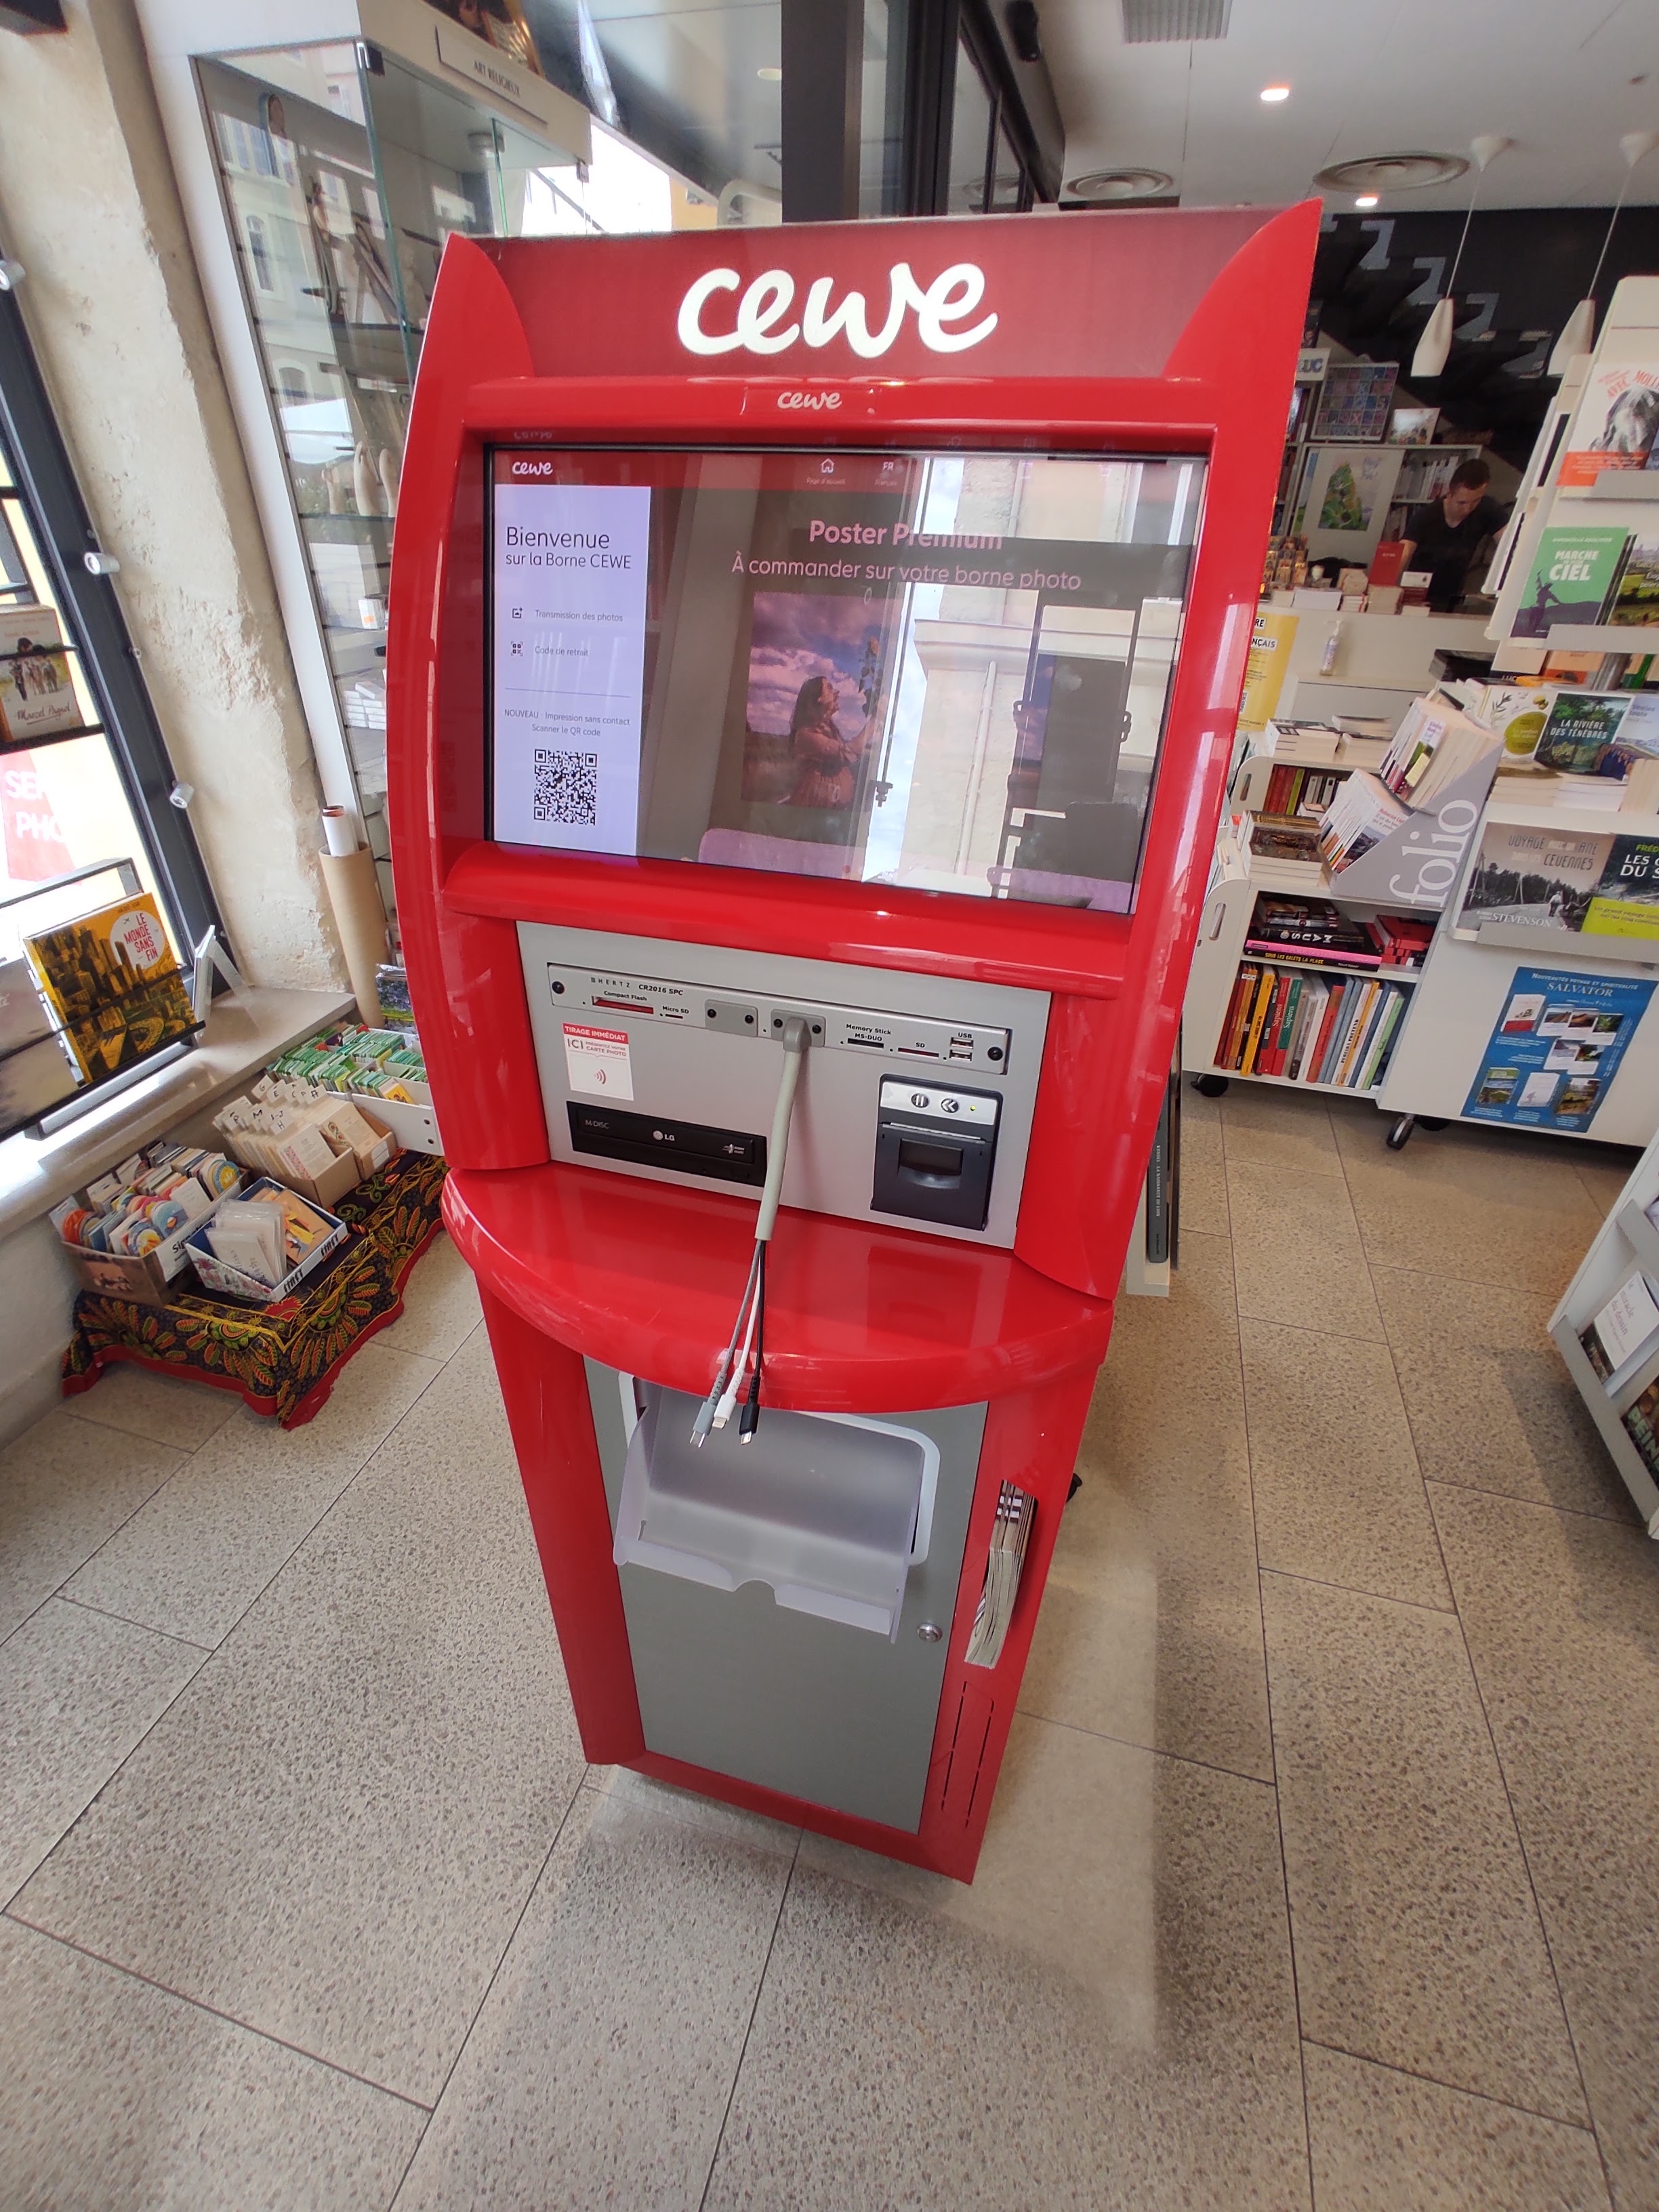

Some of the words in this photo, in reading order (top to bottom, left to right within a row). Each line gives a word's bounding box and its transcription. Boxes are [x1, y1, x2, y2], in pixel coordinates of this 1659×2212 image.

[677, 262, 999, 359] cewe
[777, 391, 842, 410] cewe
[512, 460, 553, 475] cewe
[882, 462, 894, 472] FR
[506, 527, 610, 550] Bienvenue
[810, 520, 887, 546] Poster
[893, 523, 1002, 550] Premium
[506, 554, 526, 566] sur
[529, 552, 541, 567] la
[546, 553, 586, 568] Borne
[590, 554, 632, 569] CEWE
[1554, 550, 1599, 560] MARCHE
[732, 551, 745, 573] À
[749, 558, 861, 579] commander
[865, 565, 895, 581] sur
[899, 564, 949, 584] votre
[954, 563, 1014, 588] borne
[1019, 569, 1081, 591] photo
[1549, 563, 1591, 581] CIEL
[535, 610, 580, 621] Transmission
[582, 611, 596, 621] des
[597, 612, 623, 623] photos
[535, 646, 553, 655] Code
[555, 647, 565, 656] de
[567, 647, 589, 657] retrait
[504, 709, 539, 720] NOUVEAU
[545, 712, 583, 724] Impression
[584, 716, 601, 724] sans
[602, 716, 630, 726] contact
[1560, 719, 1570, 728] LA
[1573, 719, 1605, 730] RIVIÈRE
[531, 724, 560, 735] Scanner
[561, 725, 569, 735] le
[570, 726, 581, 737] QR
[583, 727, 601, 737] code
[1551, 726, 1565, 736] DES
[1568, 728, 1609, 739] TÉNÈBRES
[1508, 834, 1544, 850] VOYAGE
[1389, 800, 1479, 907] folio
[1624, 854, 1650, 866] LES
[1544, 854, 1594, 871] CEVENNES
[1619, 865, 1647, 878] DU
[136, 912, 146, 926] LE
[1492, 912, 1553, 928] STEVENSON
[123, 926, 150, 945] MONDE
[1291, 933, 1333, 944] MAUS
[134, 939, 155, 955] SANS
[146, 947, 159, 962] FIN
[598, 978, 631, 988] HERTZ
[638, 984, 667, 994] CR2016
[668, 987, 684, 996] SPC
[1547, 982, 1613, 997] SALVATOR
[604, 990, 629, 1000] Compact
[631, 994, 647, 1002] Flash
[1273, 1004, 1283, 1027] Sapiens
[1284, 1006, 1294, 1029] Sapiens
[565, 1025, 590, 1037] TIRAGE
[592, 1028, 626, 1042] IMMÉDIAT
[846, 1024, 873, 1035] Memory
[874, 1027, 891, 1036] Stick
[855, 1033, 882, 1042] MS-DUO
[567, 1038, 583, 1050] ICI
[586, 1046, 605, 1054] CARTE
[607, 1049, 627, 1057] PHOTO
[664, 1133, 675, 1142] LG
